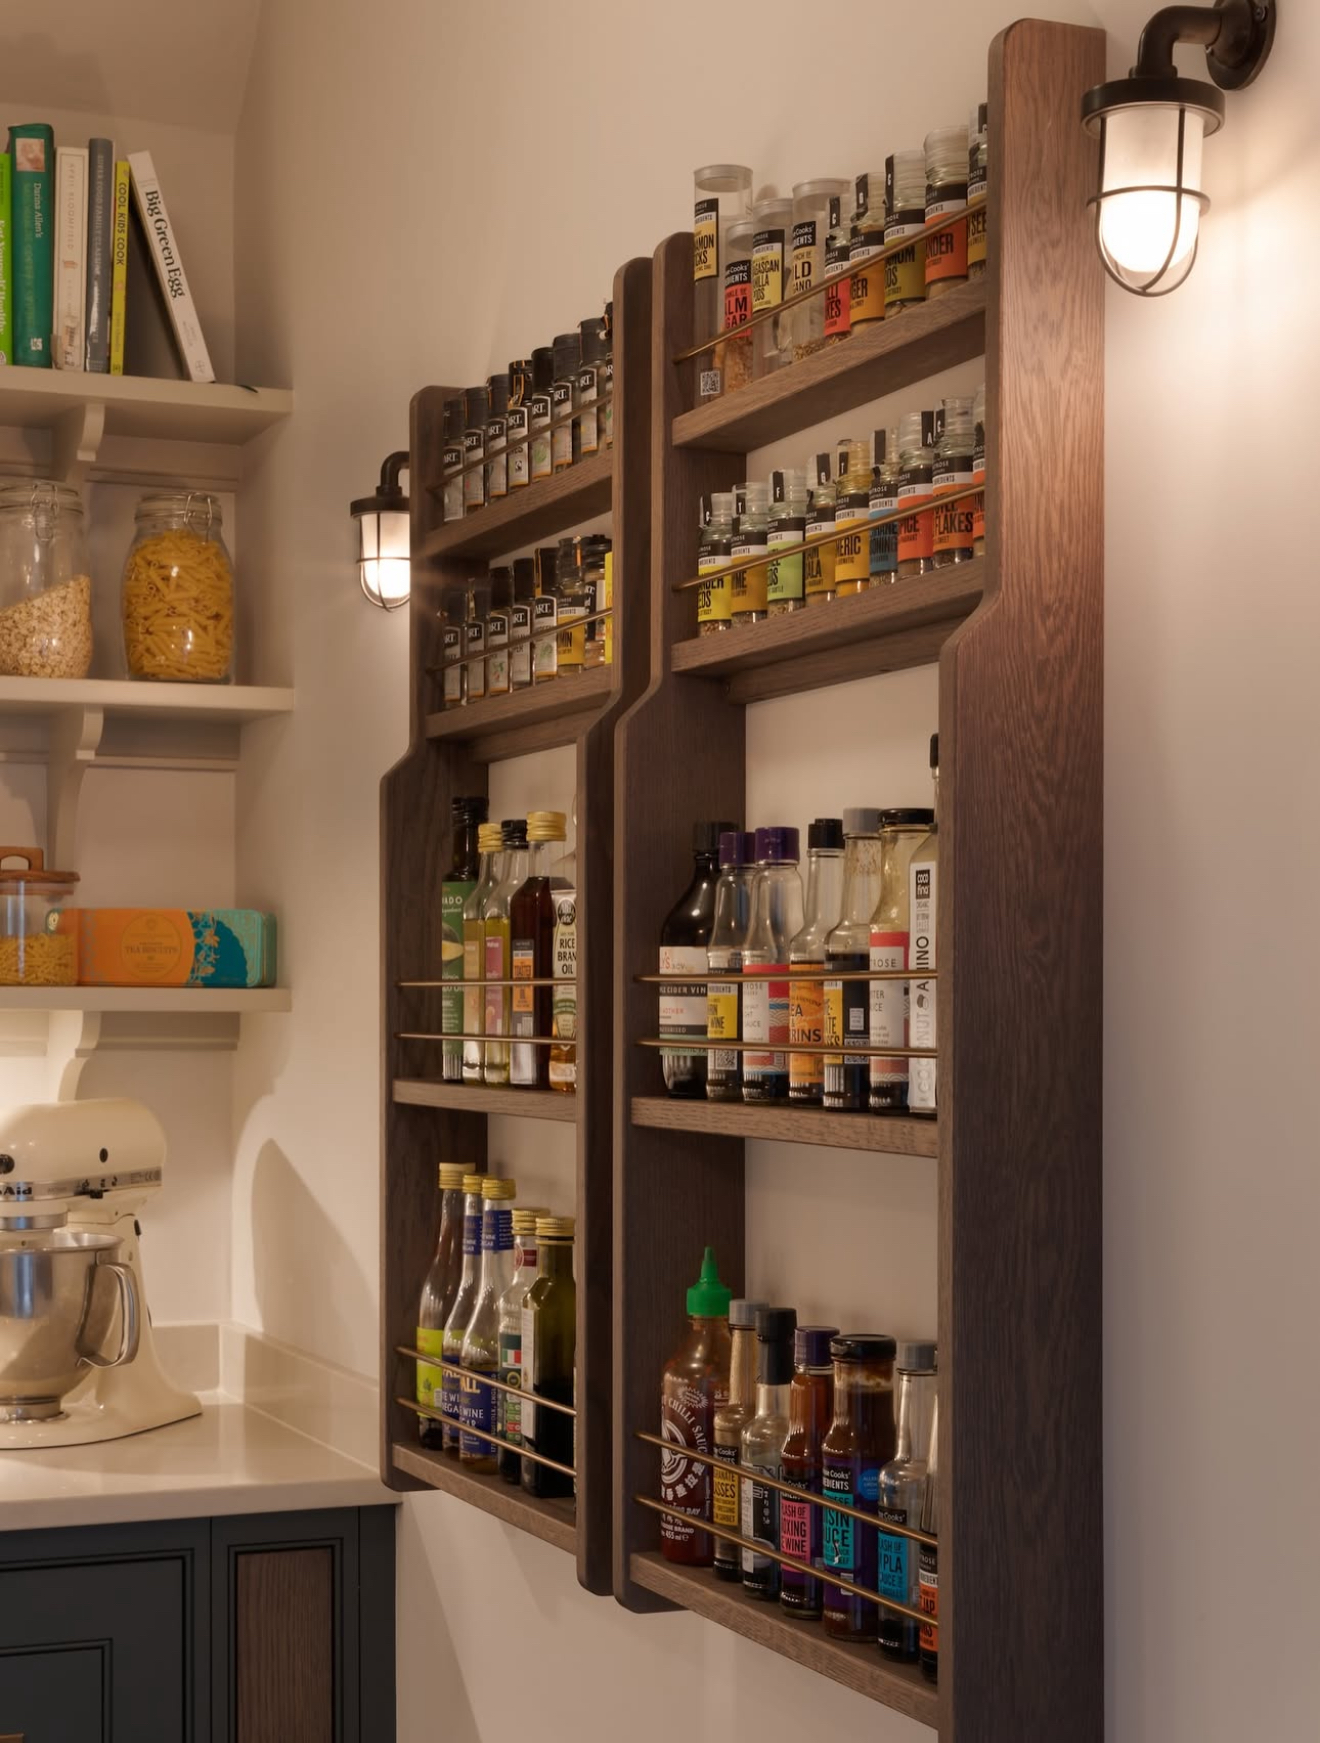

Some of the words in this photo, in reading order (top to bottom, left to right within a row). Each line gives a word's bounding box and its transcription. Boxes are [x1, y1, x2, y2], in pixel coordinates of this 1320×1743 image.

[34, 182, 42, 210] Darina
[118, 182, 127, 210] COOL
[118, 212, 126, 234] KIDS
[116, 236, 125, 266] COOK
[146, 190, 162, 218] Big
[154, 218, 176, 273] Green
[167, 267, 186, 299] Egg
[927, 432, 932, 444] A
[560, 938, 575, 949] RICE
[562, 964, 574, 975] OIL
[690, 986, 706, 994] VIN
[792, 1028, 822, 1042] RINS
[462, 1408, 484, 1418] WINE
[668, 1396, 696, 1425] CHILLI
[692, 1425, 708, 1454] SAUC
[830, 1469, 850, 1480] Cooks'
[786, 1538, 806, 1554] WINE
[884, 1554, 902, 1573] PLA
